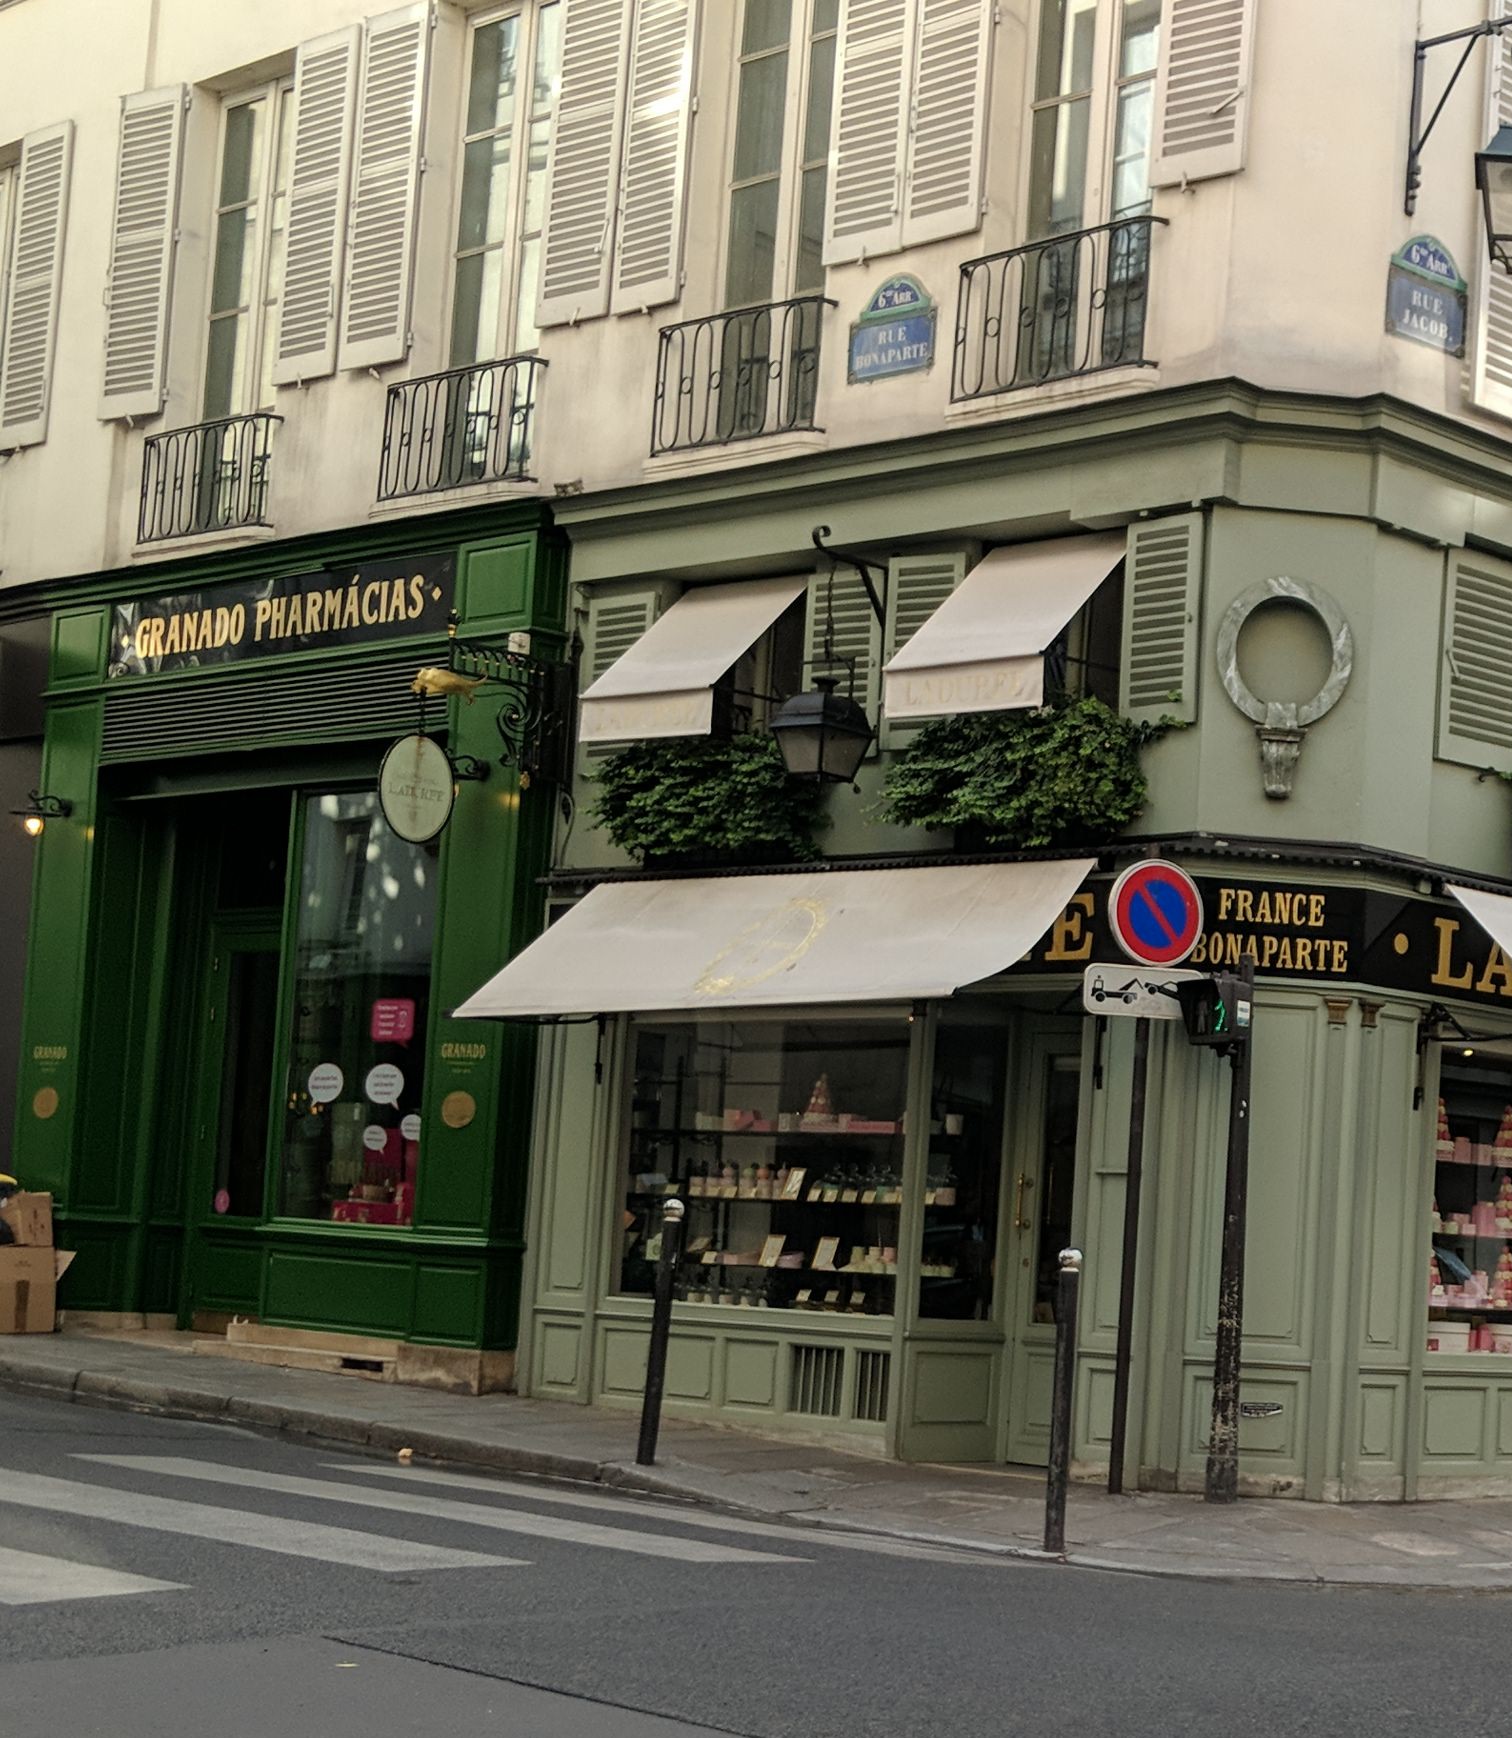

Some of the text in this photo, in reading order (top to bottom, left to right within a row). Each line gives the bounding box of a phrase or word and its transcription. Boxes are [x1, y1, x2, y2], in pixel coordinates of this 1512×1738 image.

[1412, 290, 1444, 315] RUE
[878, 326, 907, 345] RUE
[1403, 308, 1449, 340] JACOB
[855, 342, 929, 369] BONAPARTE
[135, 574, 426, 659] GRANADO PHARMÁCIAS
[1218, 887, 1326, 928] FRANCE
[1190, 930, 1349, 974] BONAPARTE
[441, 1043, 487, 1059] GRANADO
